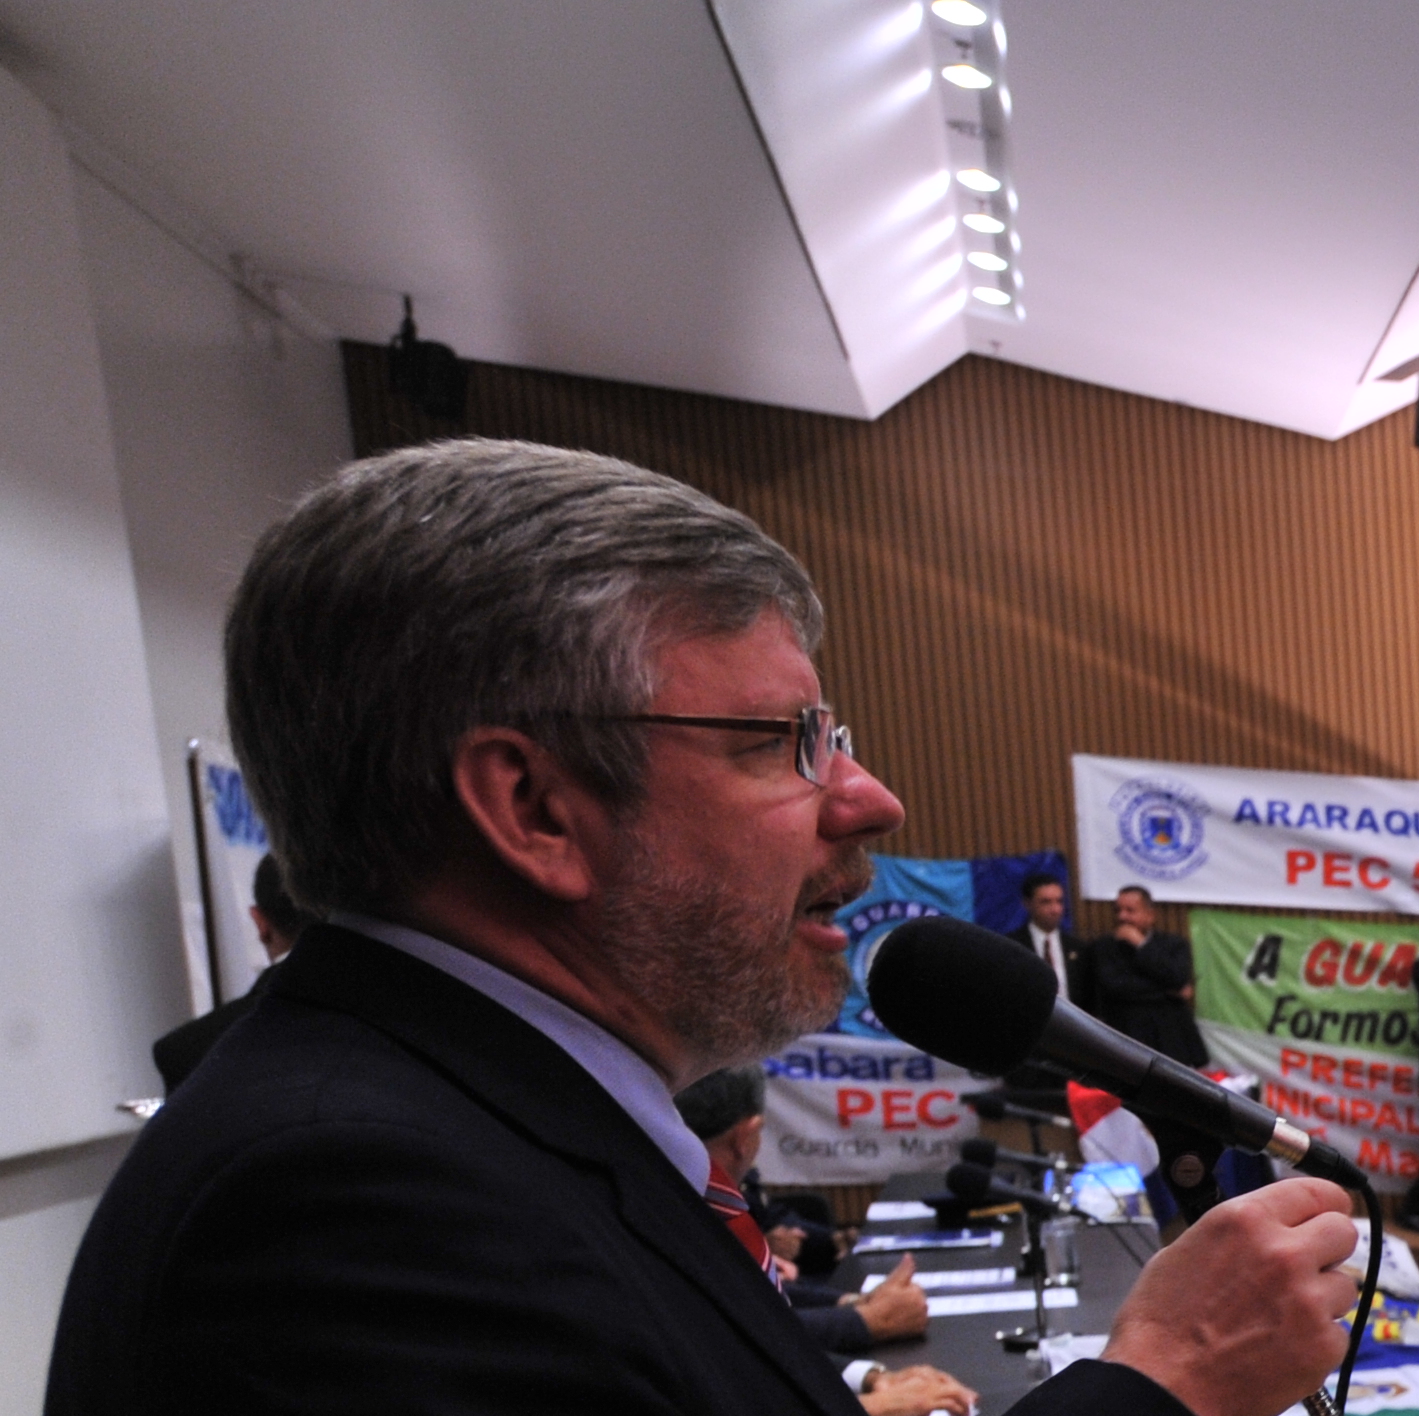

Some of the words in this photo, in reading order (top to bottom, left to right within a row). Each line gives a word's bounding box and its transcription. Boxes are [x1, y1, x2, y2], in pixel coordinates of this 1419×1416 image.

[1284, 848, 1392, 891] PEC
[1245, 933, 1284, 985] A
[836, 1086, 960, 1132] PEC
[778, 1132, 881, 1159] Guarda
